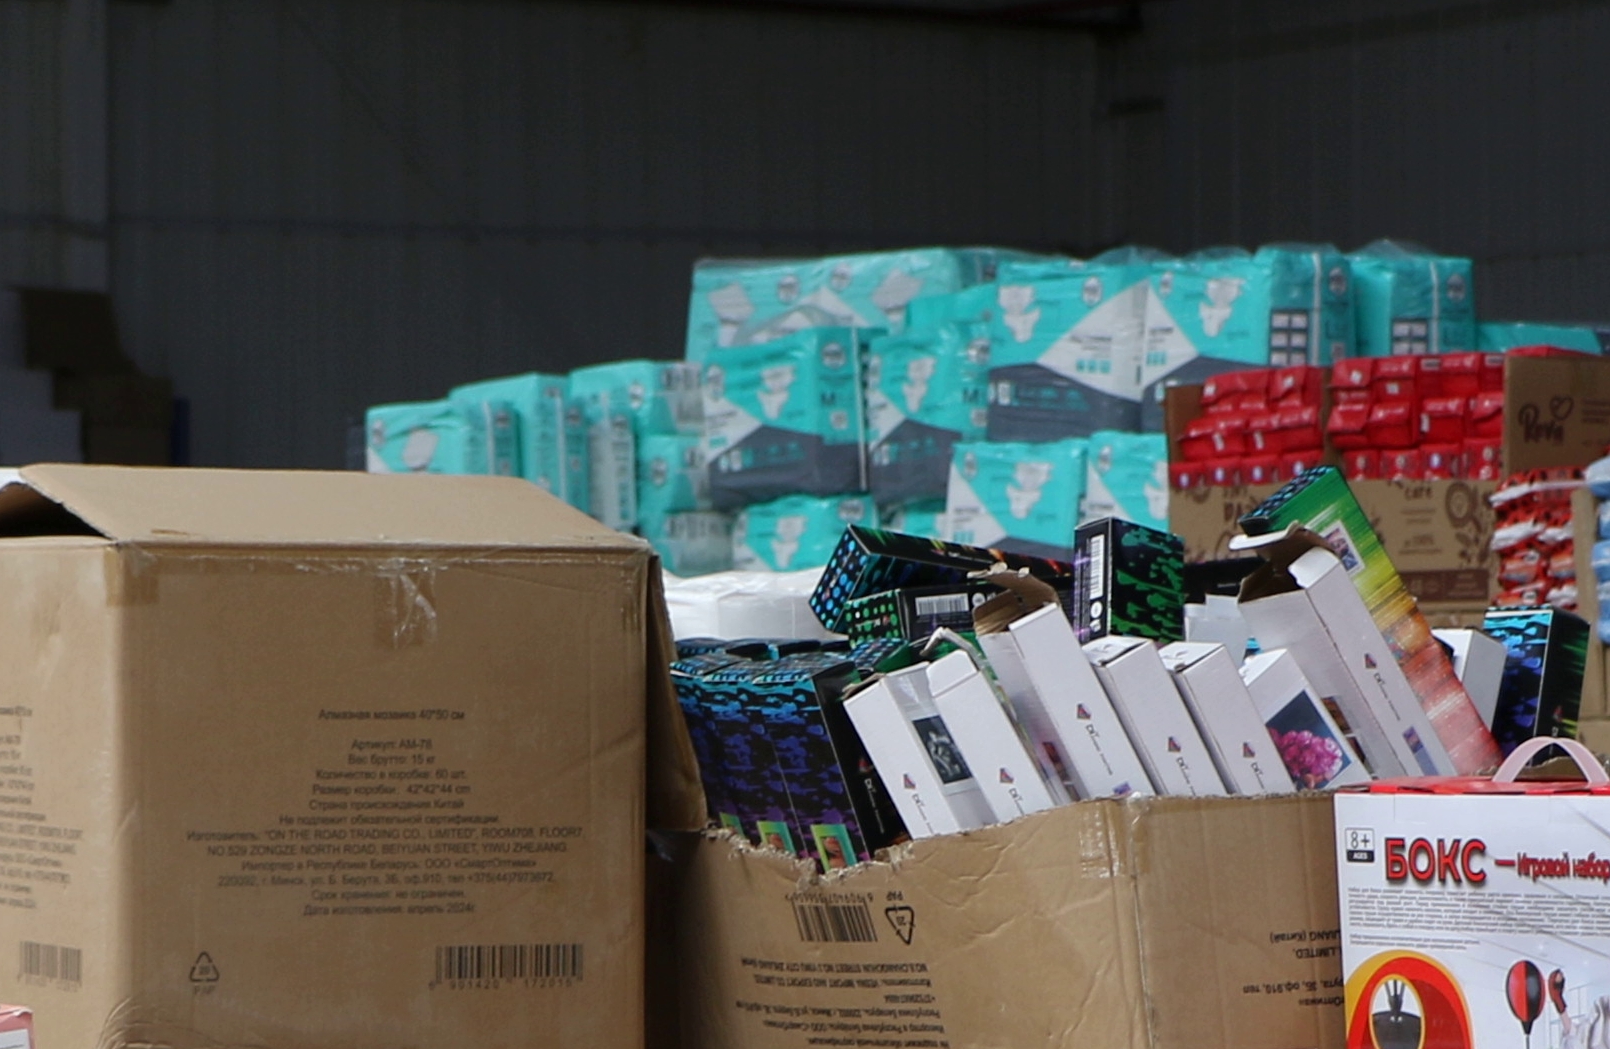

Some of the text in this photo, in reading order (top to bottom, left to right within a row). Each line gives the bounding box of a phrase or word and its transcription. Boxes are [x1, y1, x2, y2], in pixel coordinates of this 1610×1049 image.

[318, 708, 371, 721] Алмазная
[374, 711, 417, 720] мозаика
[348, 755, 367, 765] Вес
[316, 769, 377, 780] Количество
[312, 784, 351, 796] Размер
[309, 799, 465, 811] Страна происхождения Китай
[279, 815, 295, 825] Не
[297, 817, 347, 827] подлежит
[351, 814, 423, 825] обязательной
[289, 829, 312, 840] THE
[314, 829, 347, 840] ROAD
[350, 828, 400, 840] TRADING
[300, 844, 340, 856] NORTH
[381, 843, 431, 855] BEIYUAN
[1384, 836, 1488, 885] БОКС
[1516, 852, 1570, 883] Игровой
[304, 904, 329, 916] Дата
